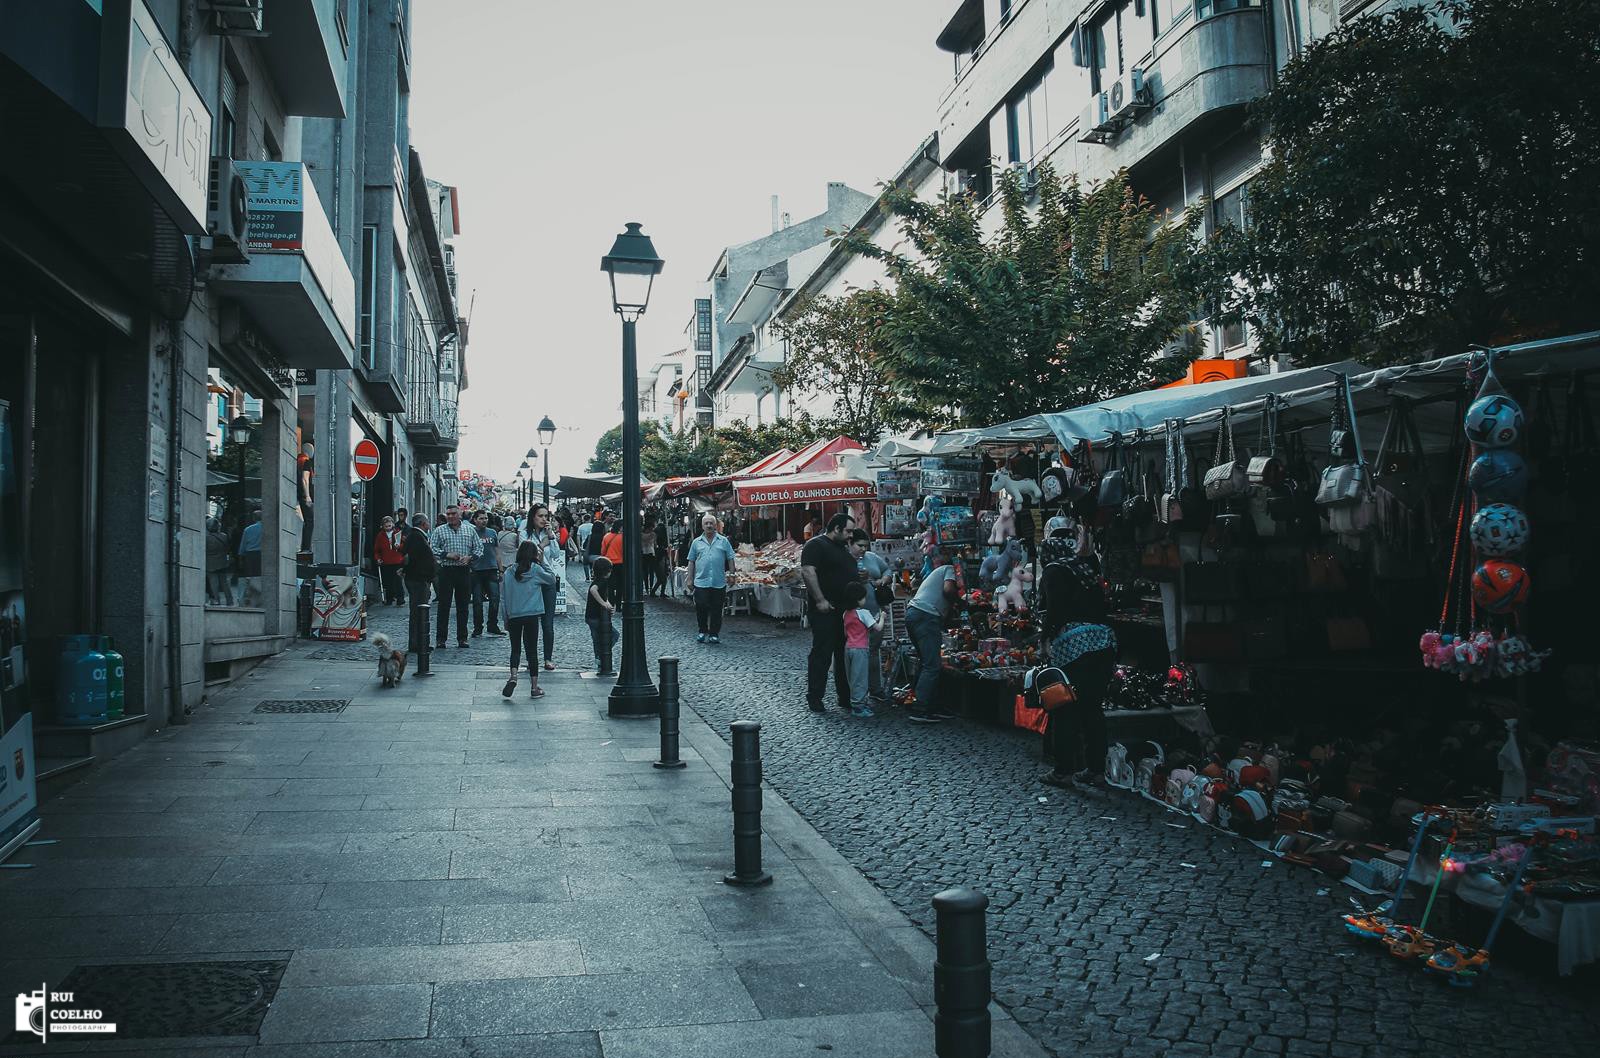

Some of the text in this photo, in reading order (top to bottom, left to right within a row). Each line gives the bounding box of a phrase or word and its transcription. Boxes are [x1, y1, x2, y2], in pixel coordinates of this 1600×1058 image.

[750, 491, 766, 502] PÃO
[767, 492, 778, 501] DE
[793, 488, 831, 499] BOLINHOS
[831, 487, 843, 496] DE
[843, 486, 865, 495] AMOR
